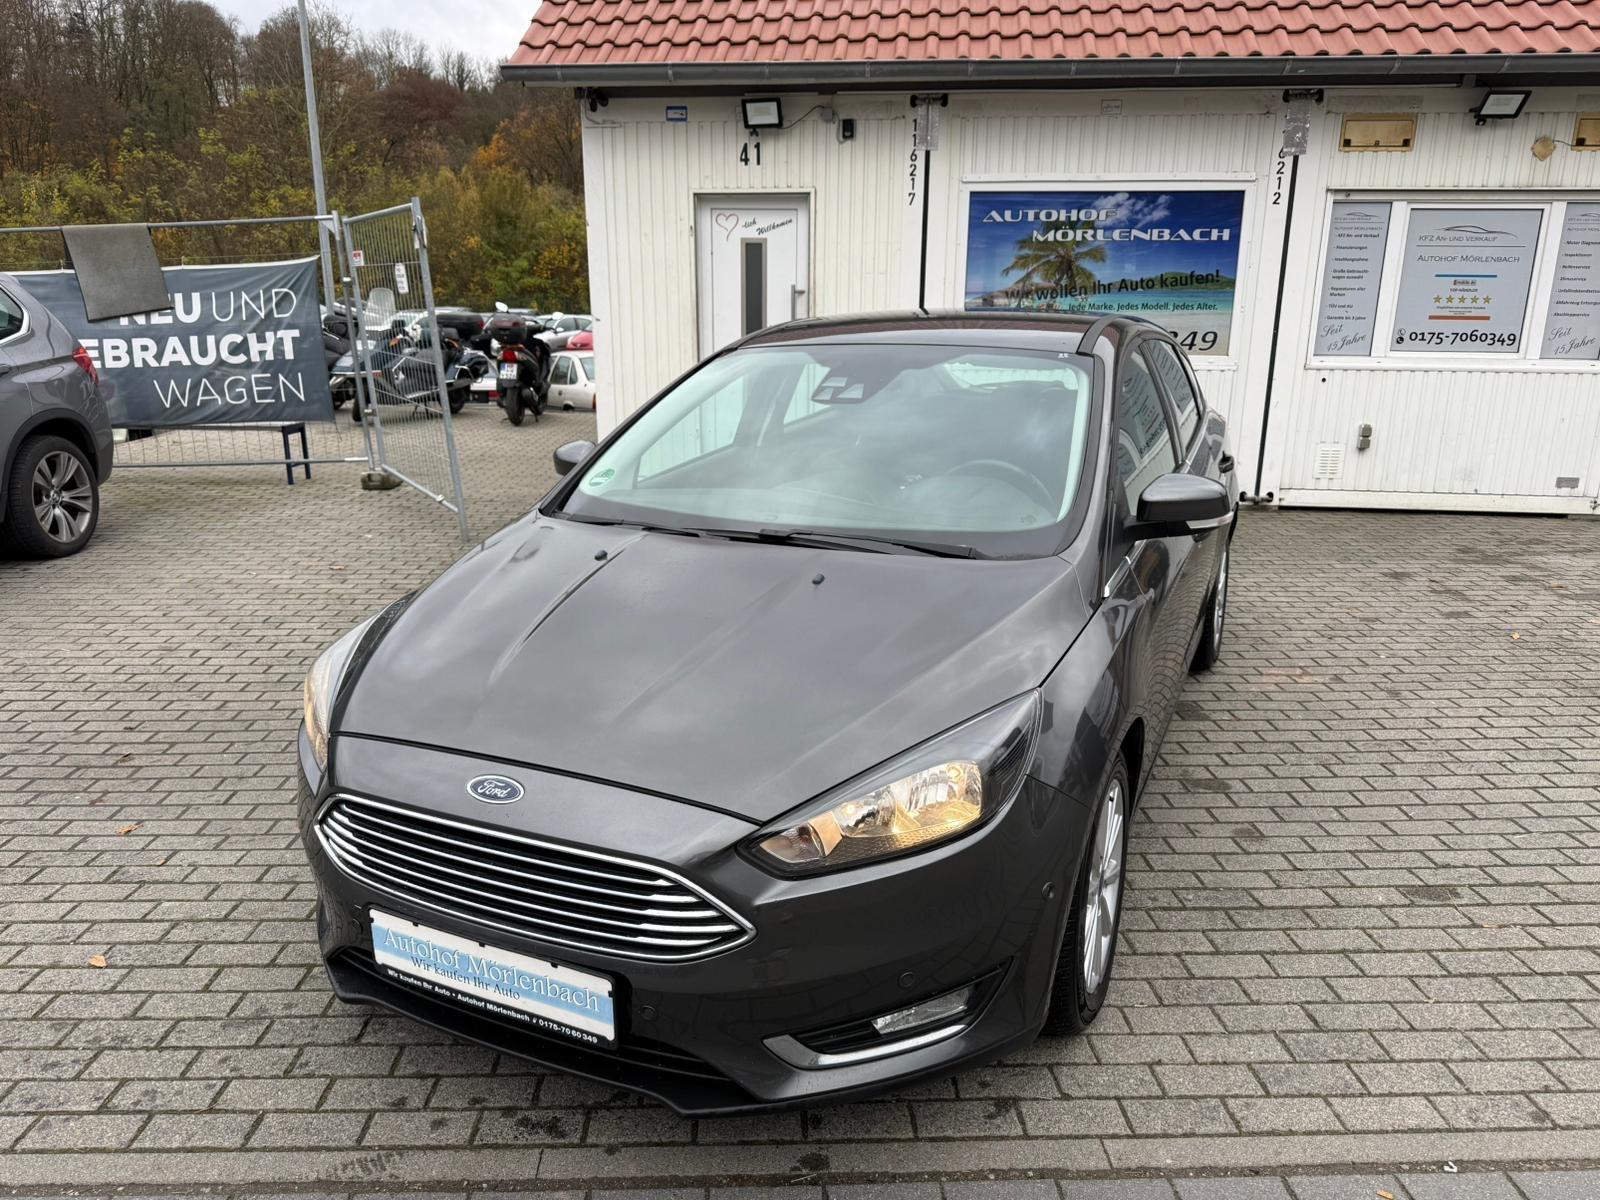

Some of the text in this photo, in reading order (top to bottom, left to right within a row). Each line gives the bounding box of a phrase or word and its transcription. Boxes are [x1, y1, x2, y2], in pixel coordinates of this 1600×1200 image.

[739, 141, 762, 167] 41
[982, 208, 1119, 223] AUTOHOF
[1031, 225, 1232, 243] MÖRLENBACH
[1416, 254, 1521, 264] AUTOHOF MÖRLENBACH
[1035, 282, 1089, 301] wollen
[1092, 279, 1114, 295] Ihr
[1118, 276, 1156, 293] Auto
[1159, 268, 1221, 288] kaufen!
[211, 287, 298, 322] UND
[1088, 303, 1116, 311] Marke.
[1117, 302, 1139, 313] Jedes
[1141, 302, 1171, 311] Modell.
[1172, 302, 1195, 313] Jedes
[1196, 302, 1219, 311] Alter.
[1408, 329, 1517, 347] 0175-7060349
[153, 372, 306, 409] WAGEN
[477, 779, 512, 798] Ford
[383, 927, 601, 1014] Autohof Mörlenbach
[410, 955, 521, 1000] Wir kaufen Ihr Auto
[456, 993, 486, 1008] Autohof
[486, 1001, 530, 1022] Mörlenbach
